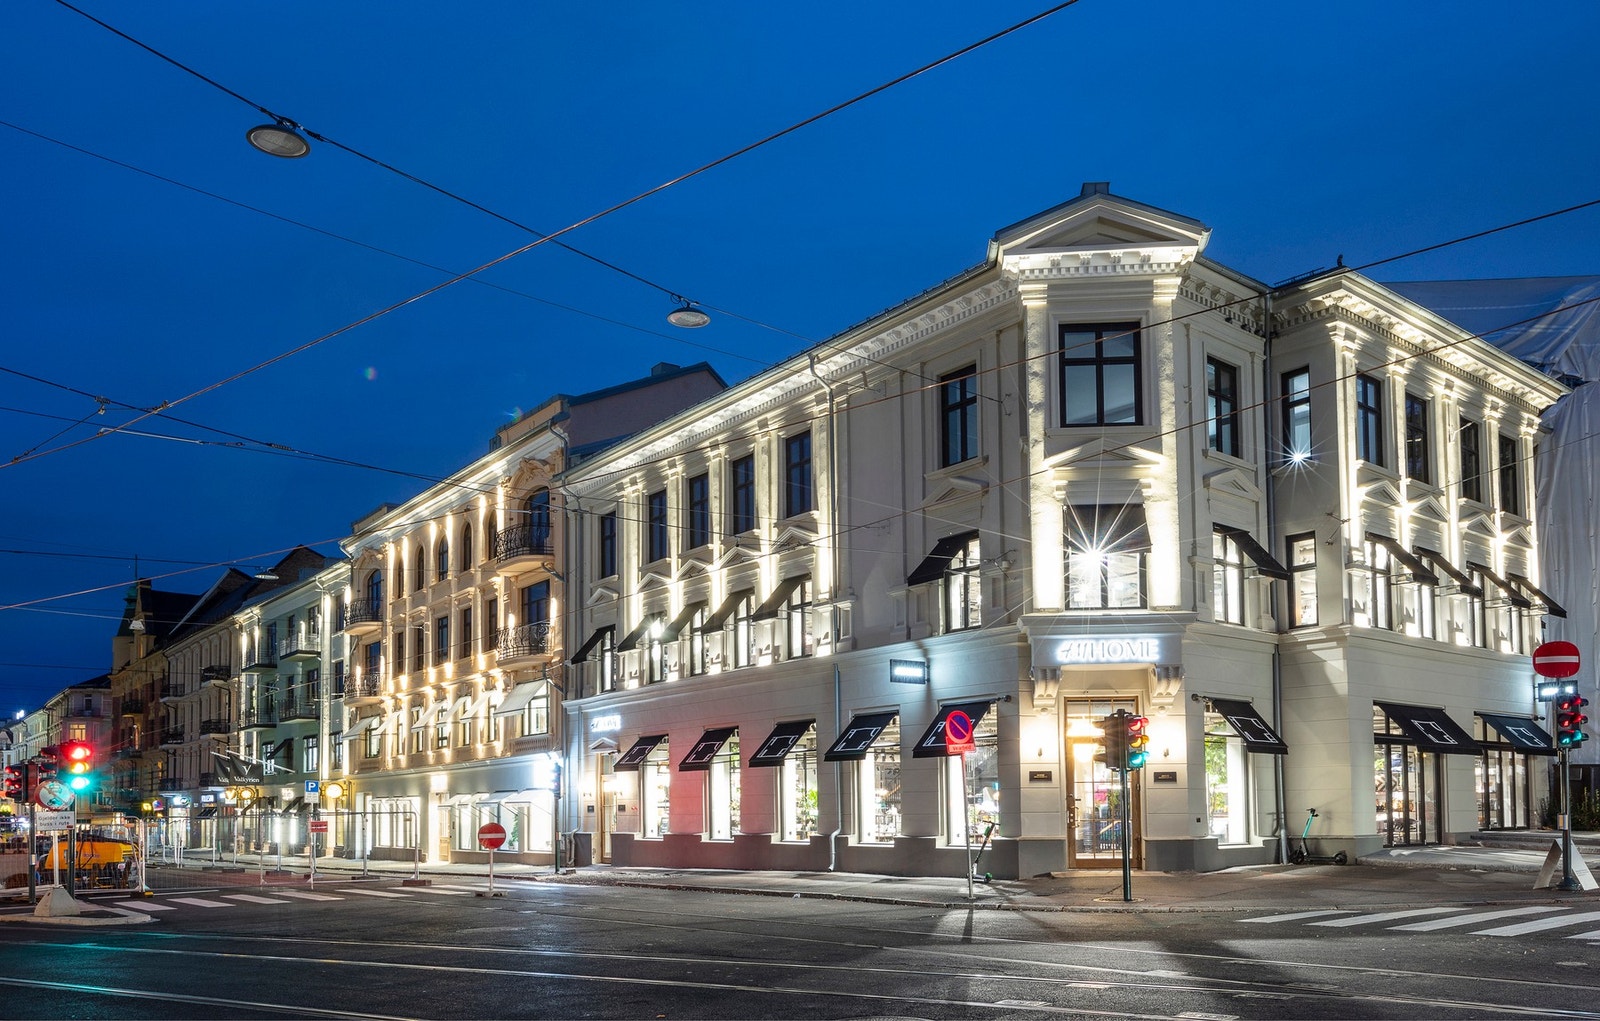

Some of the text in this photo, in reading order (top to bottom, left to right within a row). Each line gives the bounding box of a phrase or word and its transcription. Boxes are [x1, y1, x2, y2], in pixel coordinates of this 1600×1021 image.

[1090, 640, 1159, 659] HOME
[234, 776, 260, 784] Valkyrien
[308, 782, 316, 791] P
